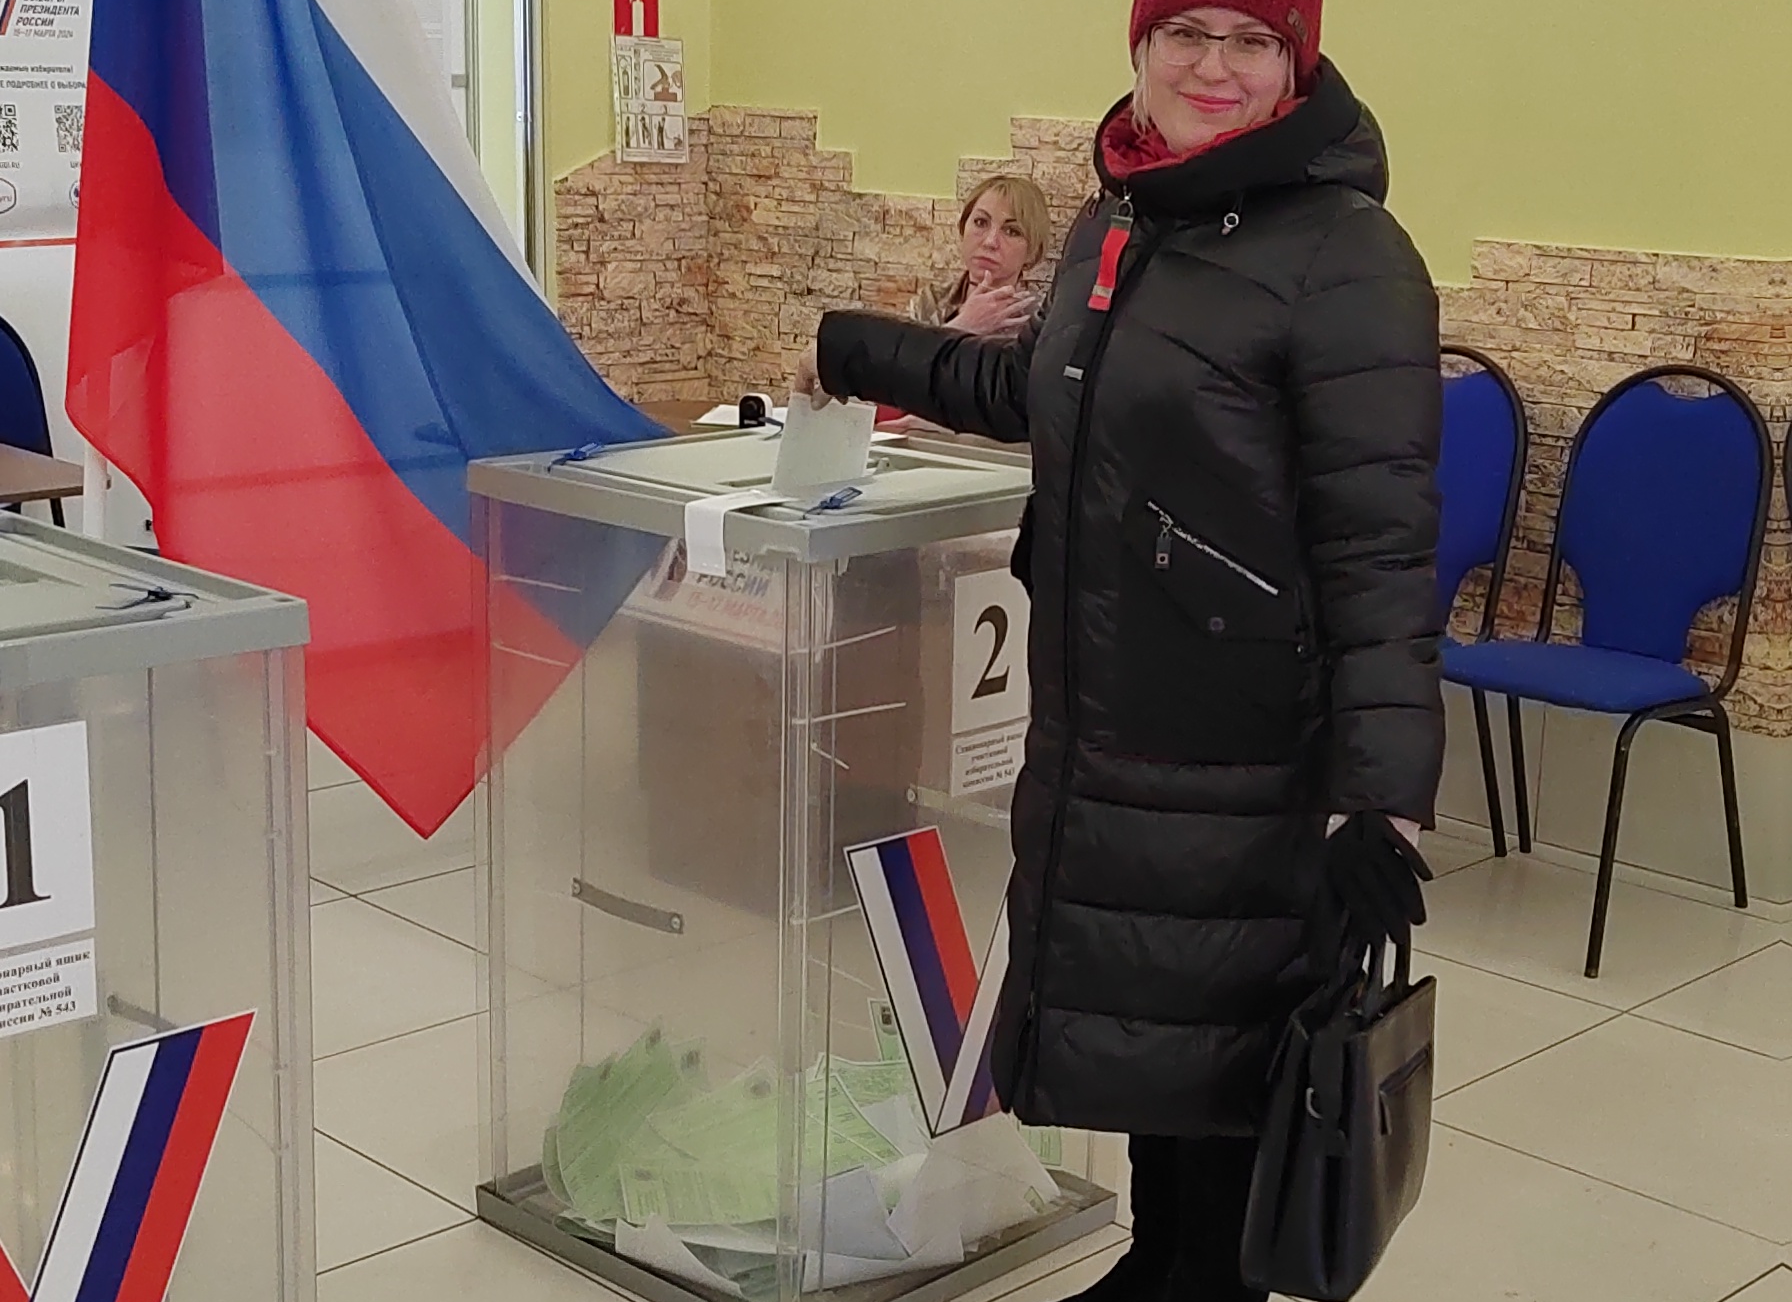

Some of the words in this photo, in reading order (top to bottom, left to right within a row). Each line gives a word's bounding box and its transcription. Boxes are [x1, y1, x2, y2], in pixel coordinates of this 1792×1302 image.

[20, 4, 80, 16] ПРЕЗИДЕНТА
[16, 16, 55, 27] РОССИИ
[971, 604, 1011, 700] 2
[56, 951, 91, 966] ящик
[56, 1001, 76, 1016] 543
